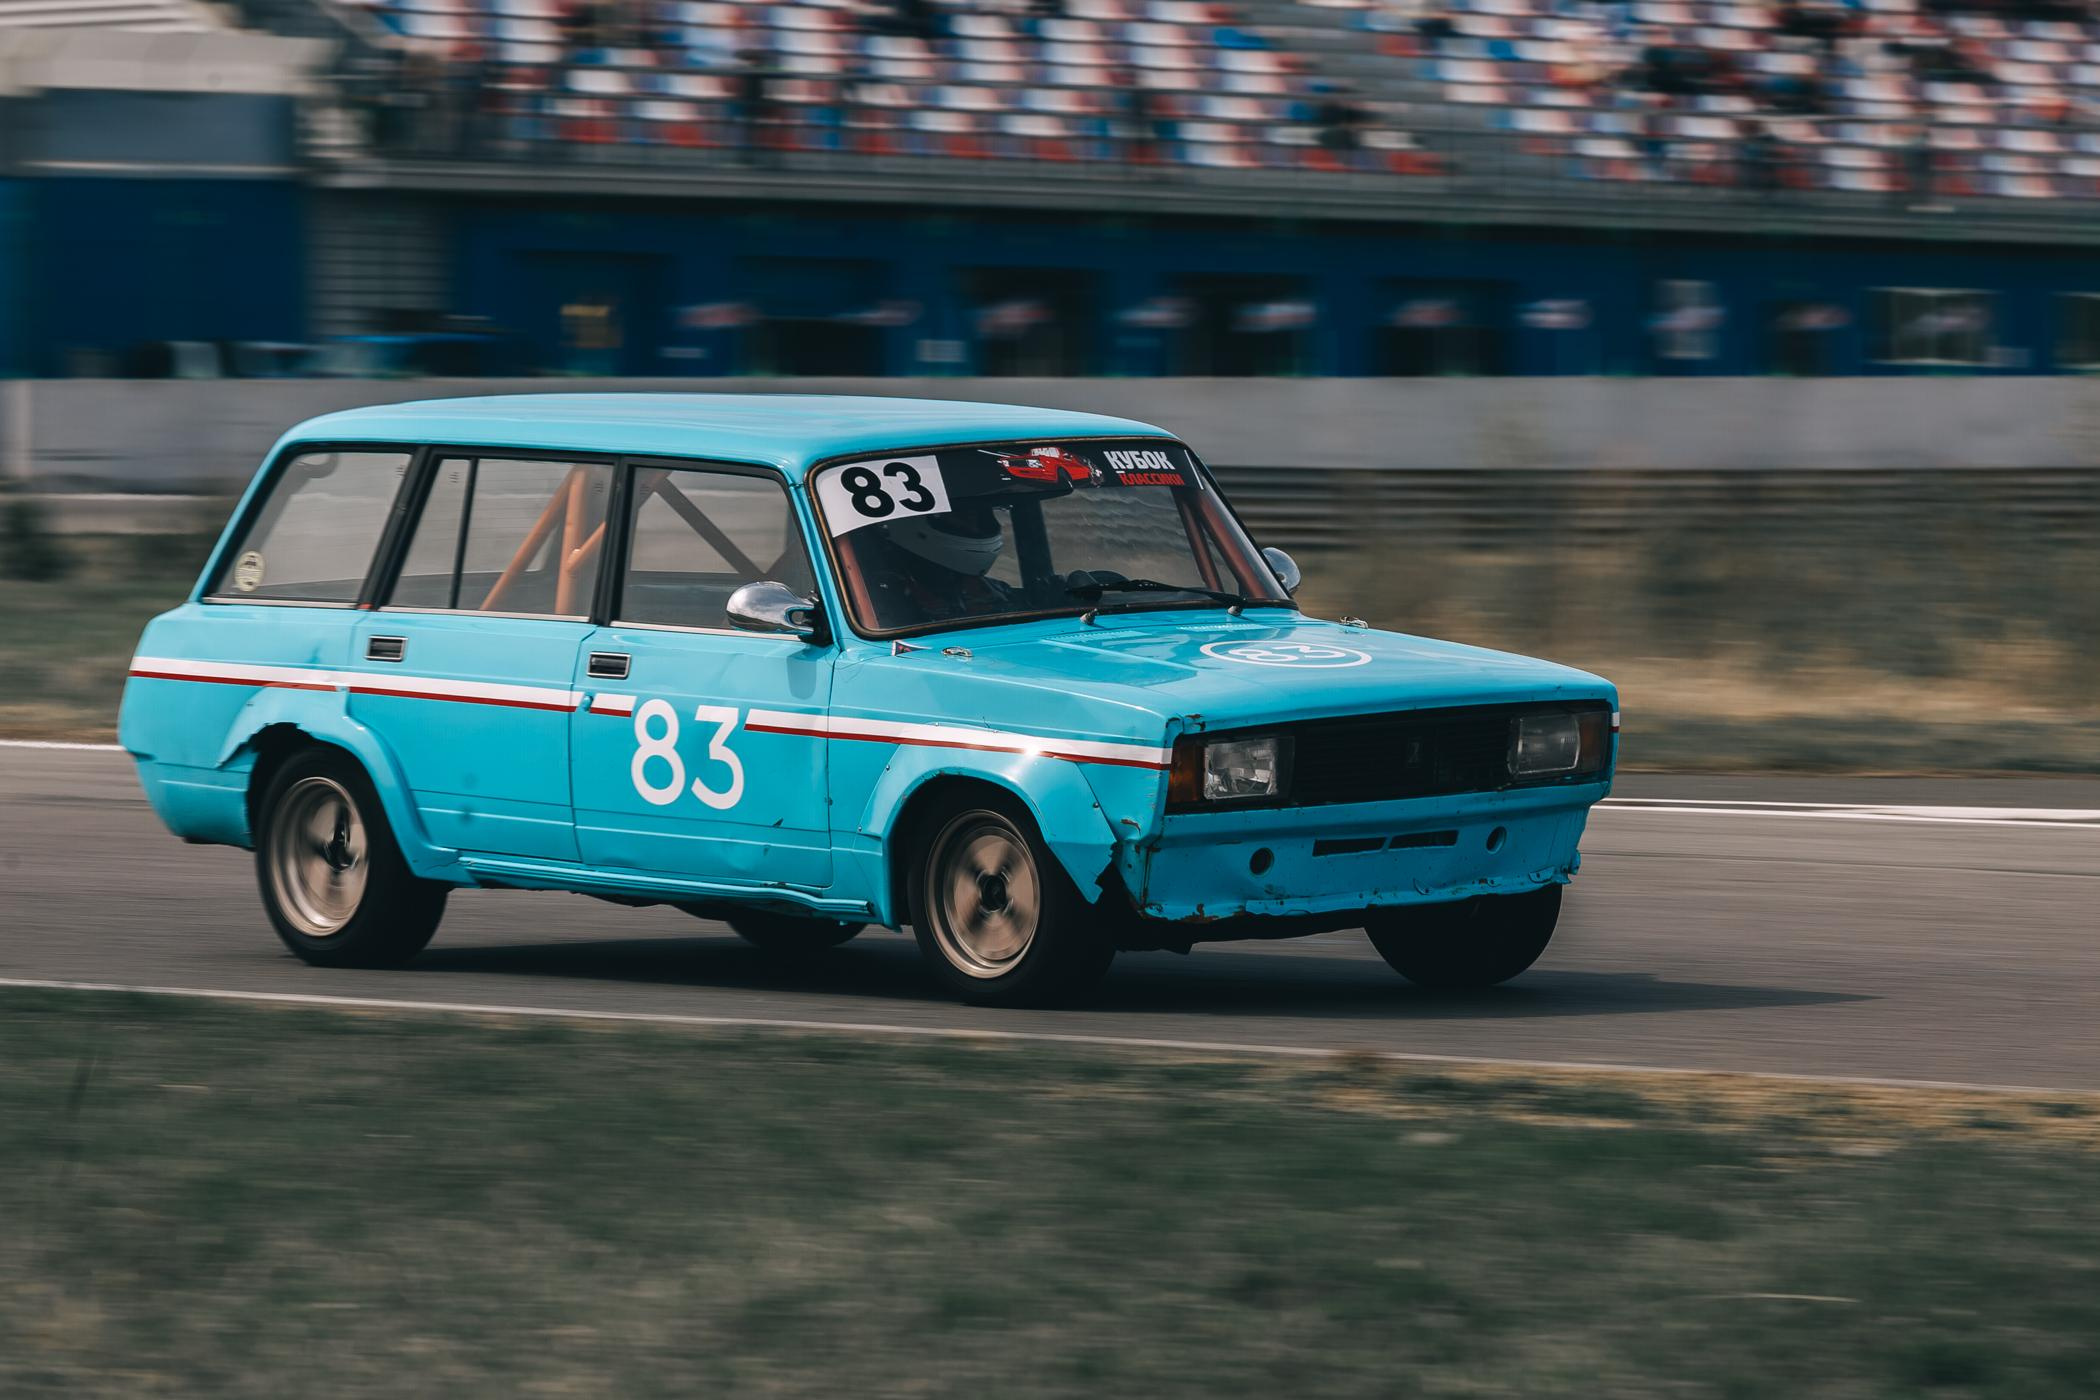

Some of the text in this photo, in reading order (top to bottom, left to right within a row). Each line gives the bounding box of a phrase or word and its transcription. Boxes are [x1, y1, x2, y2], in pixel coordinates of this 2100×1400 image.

[1103, 450, 1176, 470] КУБОК
[840, 461, 936, 518] 83
[1228, 645, 1346, 662] 83
[630, 698, 745, 810] 83
